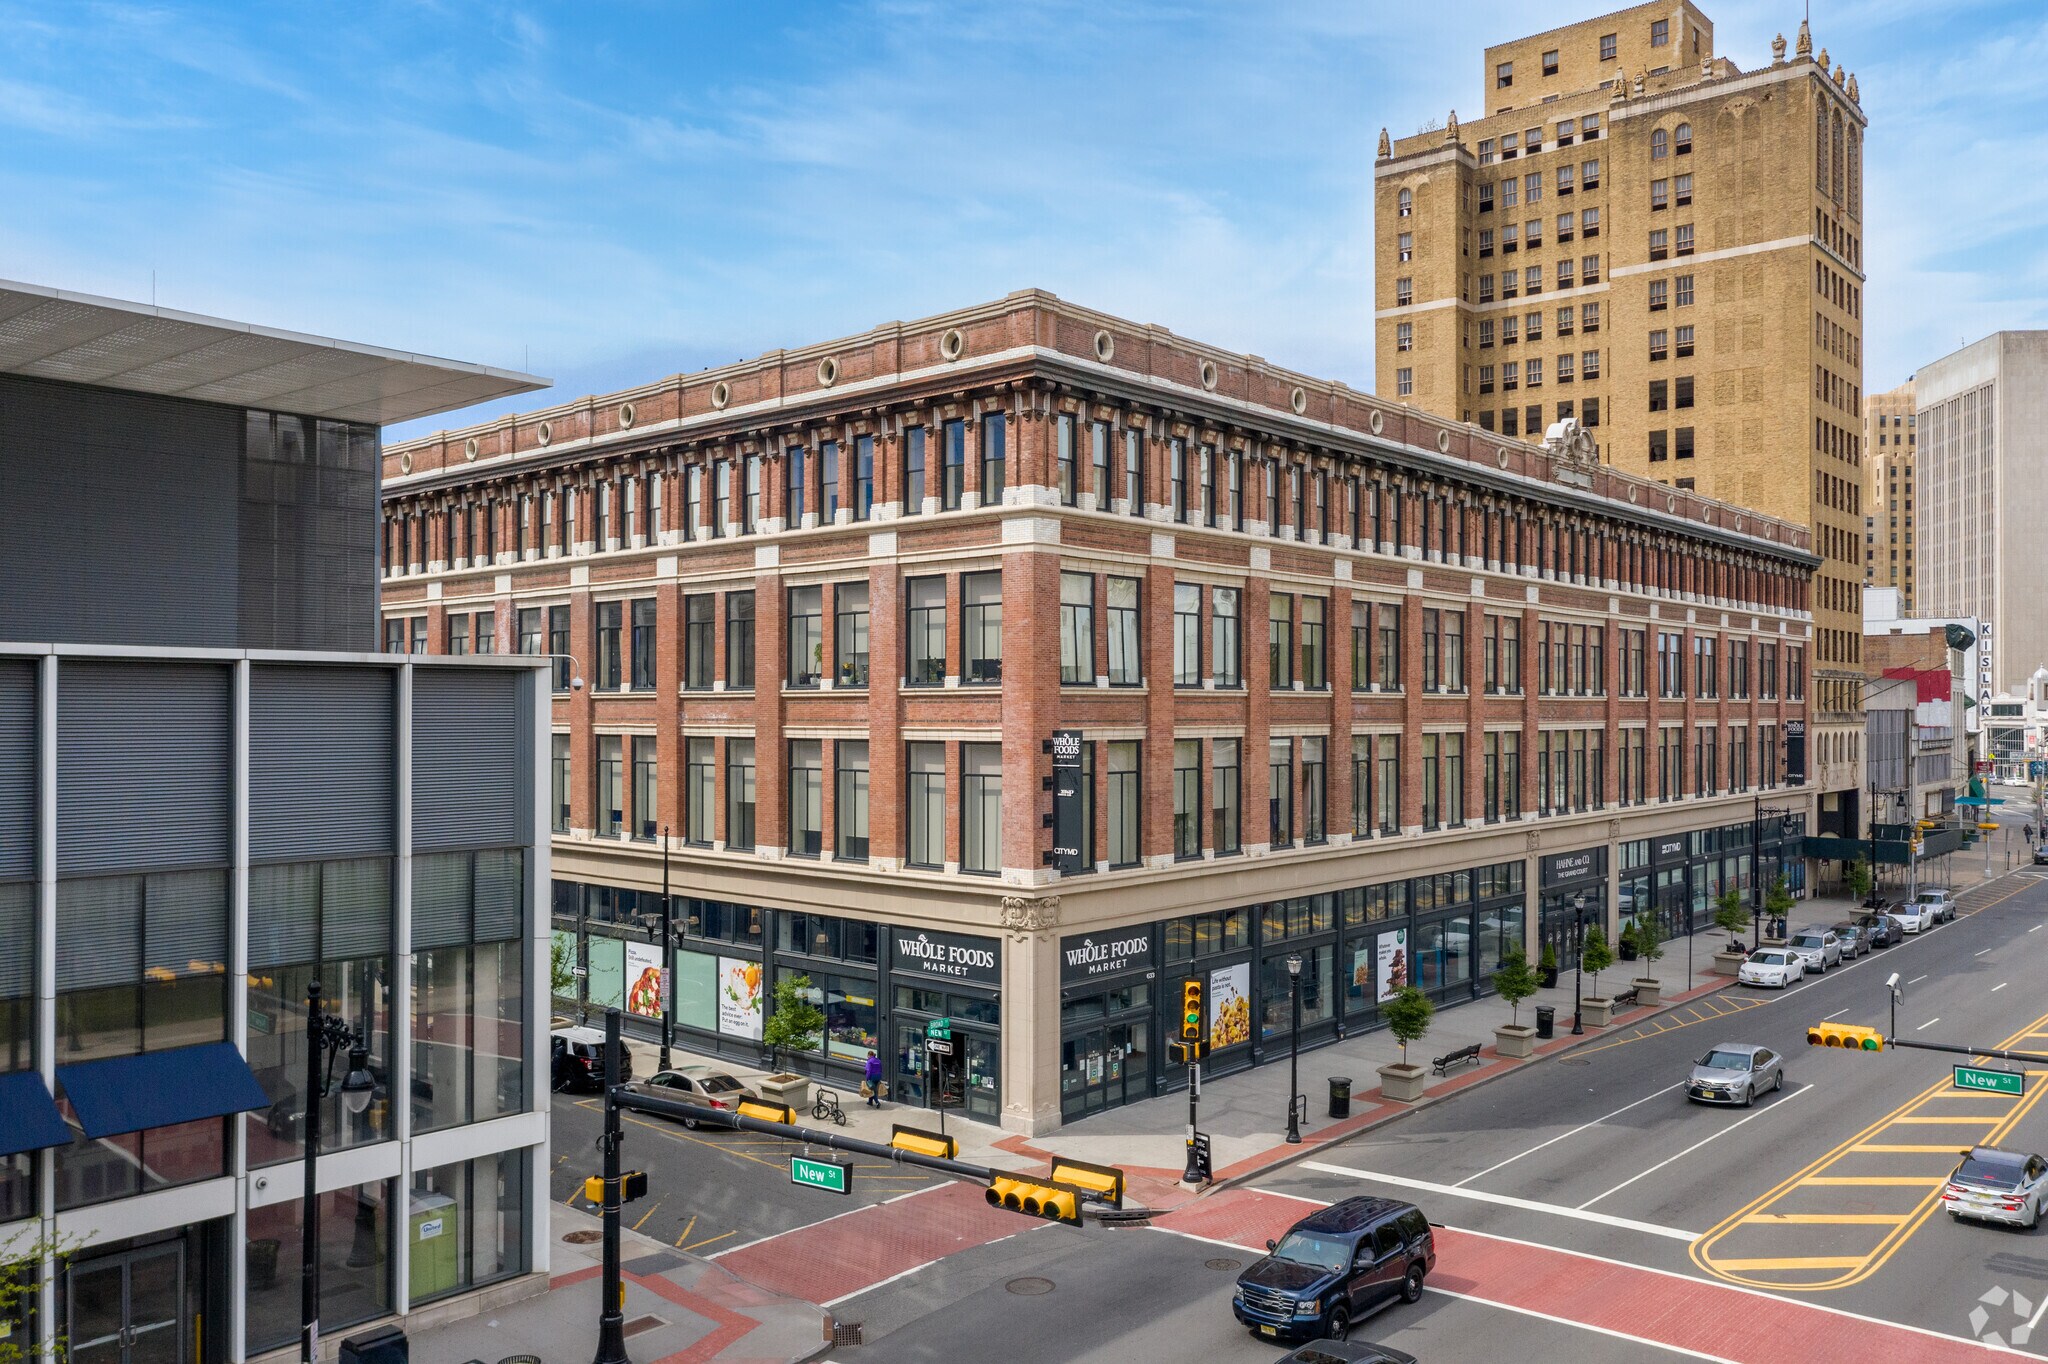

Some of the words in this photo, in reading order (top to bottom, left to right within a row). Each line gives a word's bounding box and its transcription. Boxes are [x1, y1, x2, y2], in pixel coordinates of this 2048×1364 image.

[1981, 624, 1990, 716] KISLAK
[1053, 736, 1080, 746] WHOLE
[1054, 745, 1080, 754] FOODS
[1054, 847, 1078, 855] CITYMD
[1556, 857, 1574, 869] HAHNE
[1565, 869, 1577, 877] GRAND
[899, 937, 946, 961] WHOLE
[949, 946, 994, 968] FOODS
[1066, 941, 1109, 966] WHOLE
[1111, 937, 1148, 958] FOODS
[923, 961, 968, 976] MARKET
[1089, 959, 1127, 974] MARKET
[930, 1020, 943, 1029] BROAD
[930, 1029, 942, 1037] NEW
[1965, 1072, 1997, 1087] New
[800, 1164, 825, 1182] New
[828, 1170, 836, 1179] St
